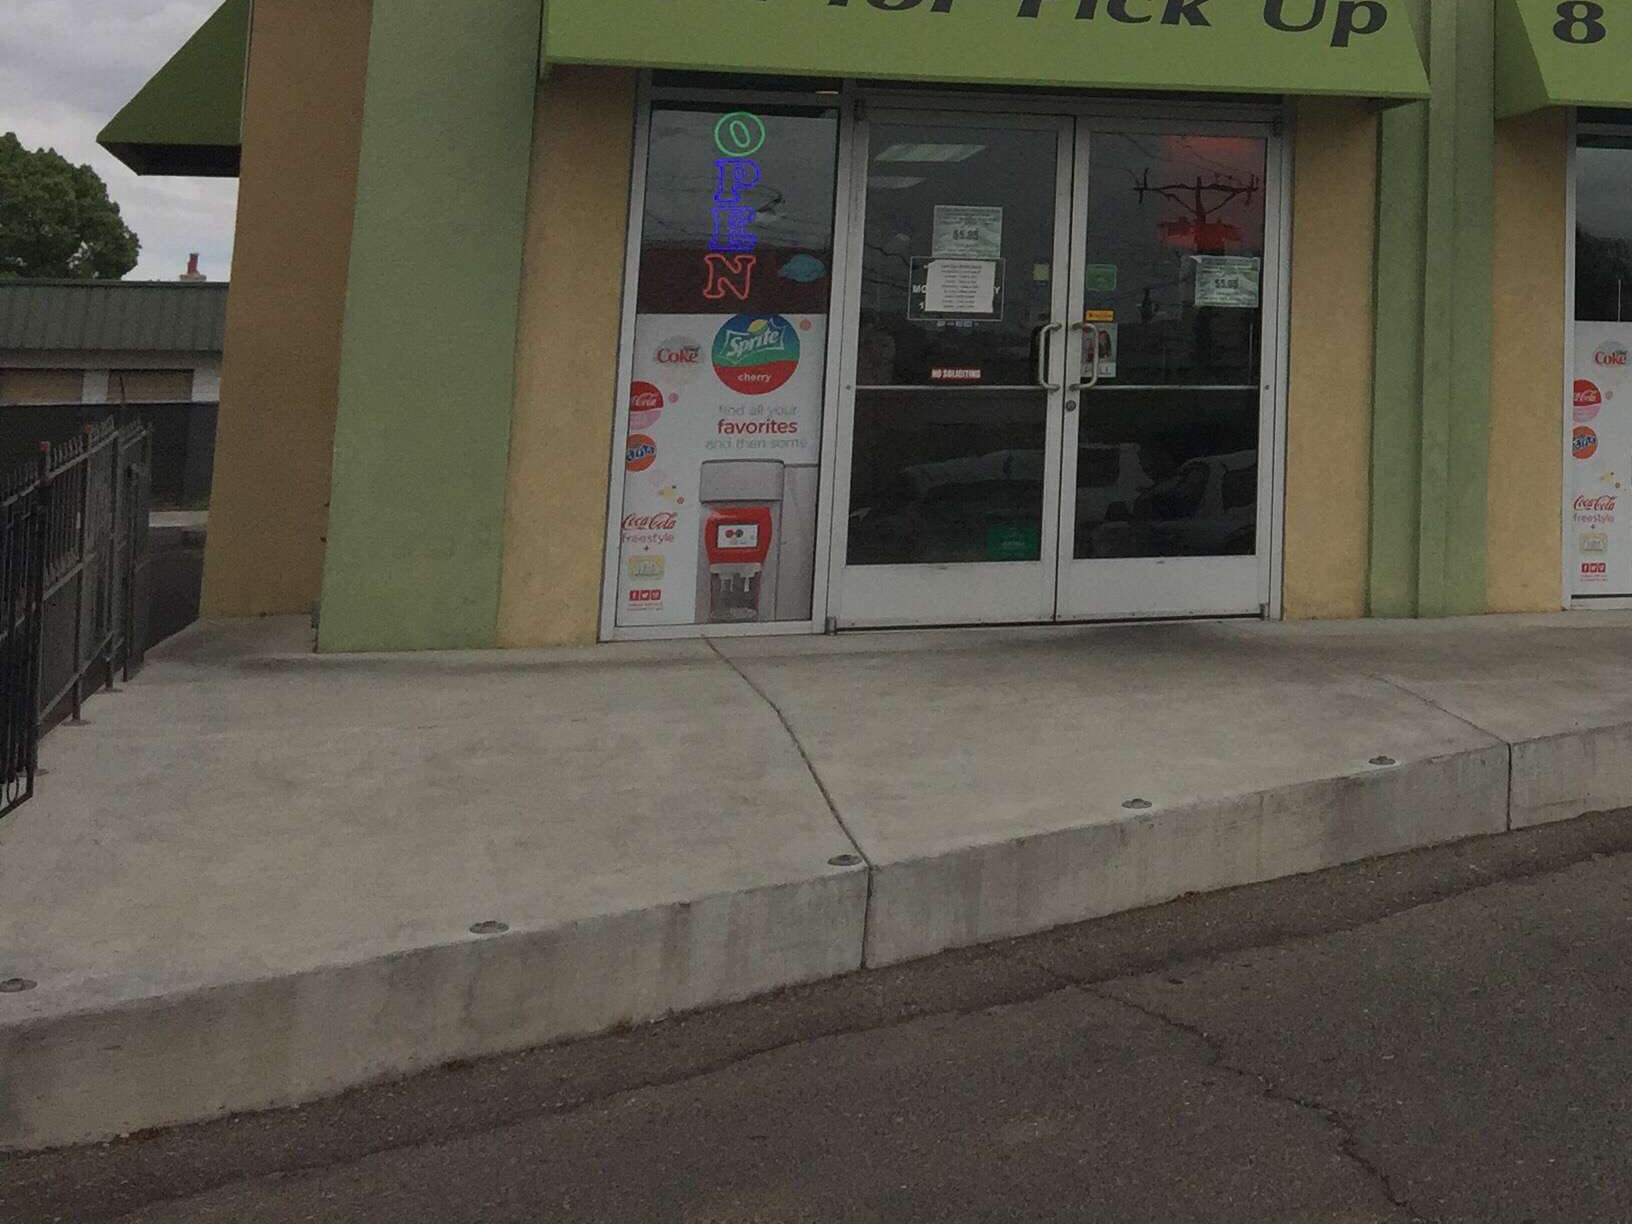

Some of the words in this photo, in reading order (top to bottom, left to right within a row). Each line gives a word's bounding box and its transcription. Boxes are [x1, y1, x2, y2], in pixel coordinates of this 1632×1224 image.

[703, 110, 766, 300] OPEN
[727, 328, 779, 356] Sprite
[656, 347, 699, 364] Coke
[1594, 350, 1627, 365] Coke
[737, 373, 772, 383] cherry
[717, 418, 799, 434] favorites
[1573, 494, 1617, 512] Coca-Cola
[622, 511, 678, 530] Coca-Cola
